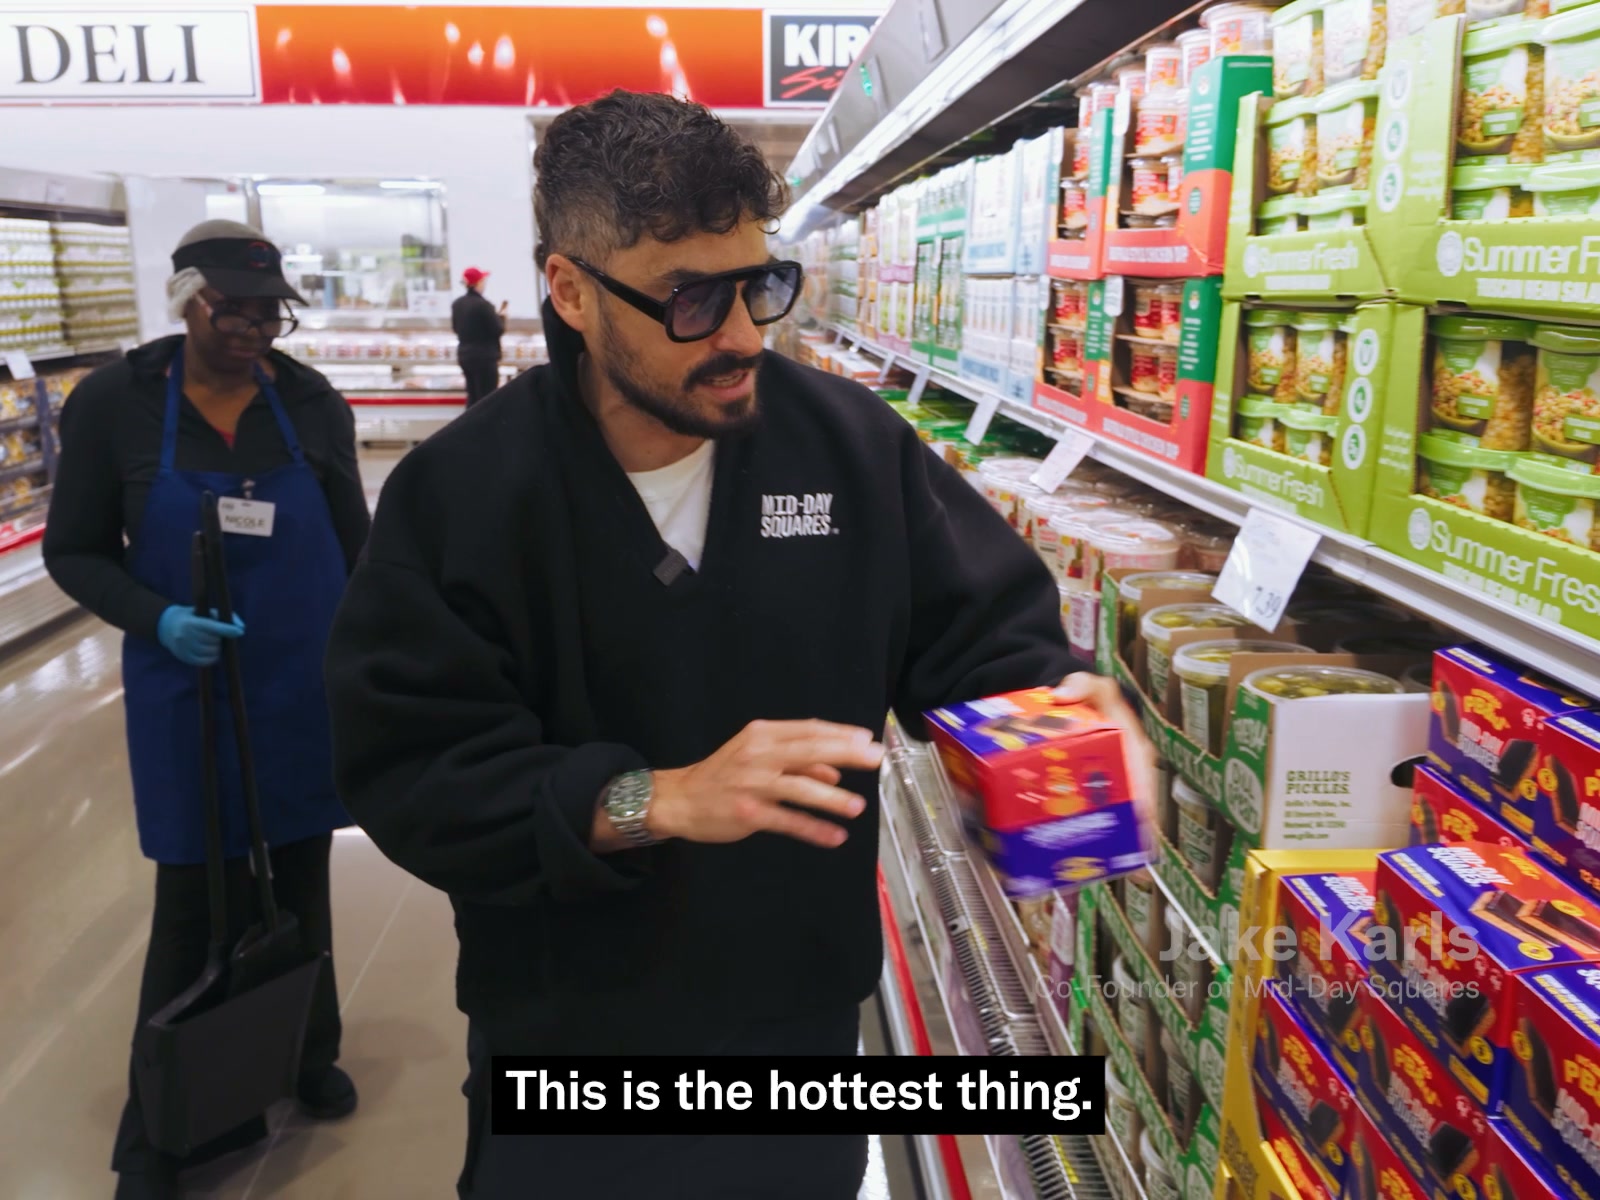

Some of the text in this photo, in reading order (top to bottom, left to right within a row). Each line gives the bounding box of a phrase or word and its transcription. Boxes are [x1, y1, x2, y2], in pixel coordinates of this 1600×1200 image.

[10, 24, 206, 84] DELI
[784, 23, 874, 67] KIR
[1463, 236, 1579, 275] Summer
[761, 493, 834, 516] MID-DAY
[1432, 520, 1600, 616] Summer Fres
[1287, 770, 1351, 782] GRILLO'S
